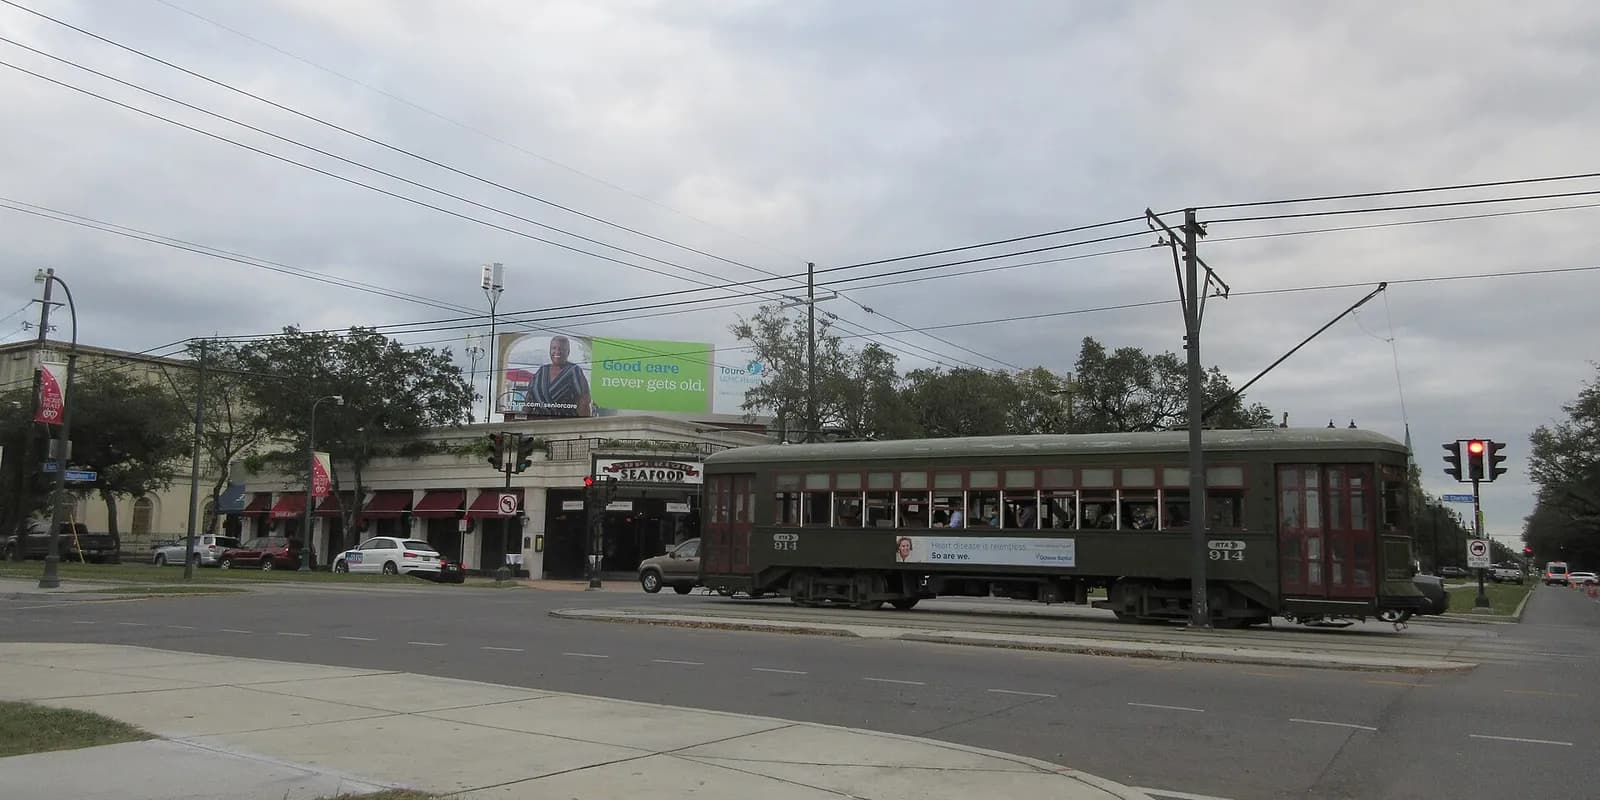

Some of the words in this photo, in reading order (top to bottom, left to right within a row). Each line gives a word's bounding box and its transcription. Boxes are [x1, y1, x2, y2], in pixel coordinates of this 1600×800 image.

[603, 359, 641, 373] Good
[646, 362, 680, 374] care
[720, 366, 746, 375] Touro
[602, 376, 644, 389] never
[647, 379, 677, 392] gets
[680, 379, 705, 392] old.
[621, 469, 685, 481] SEAFOOD
[774, 541, 797, 550] 914
[931, 542, 951, 551] Heart
[953, 543, 981, 552] disease
[931, 551, 942, 560] So
[1208, 550, 1243, 560] 914
